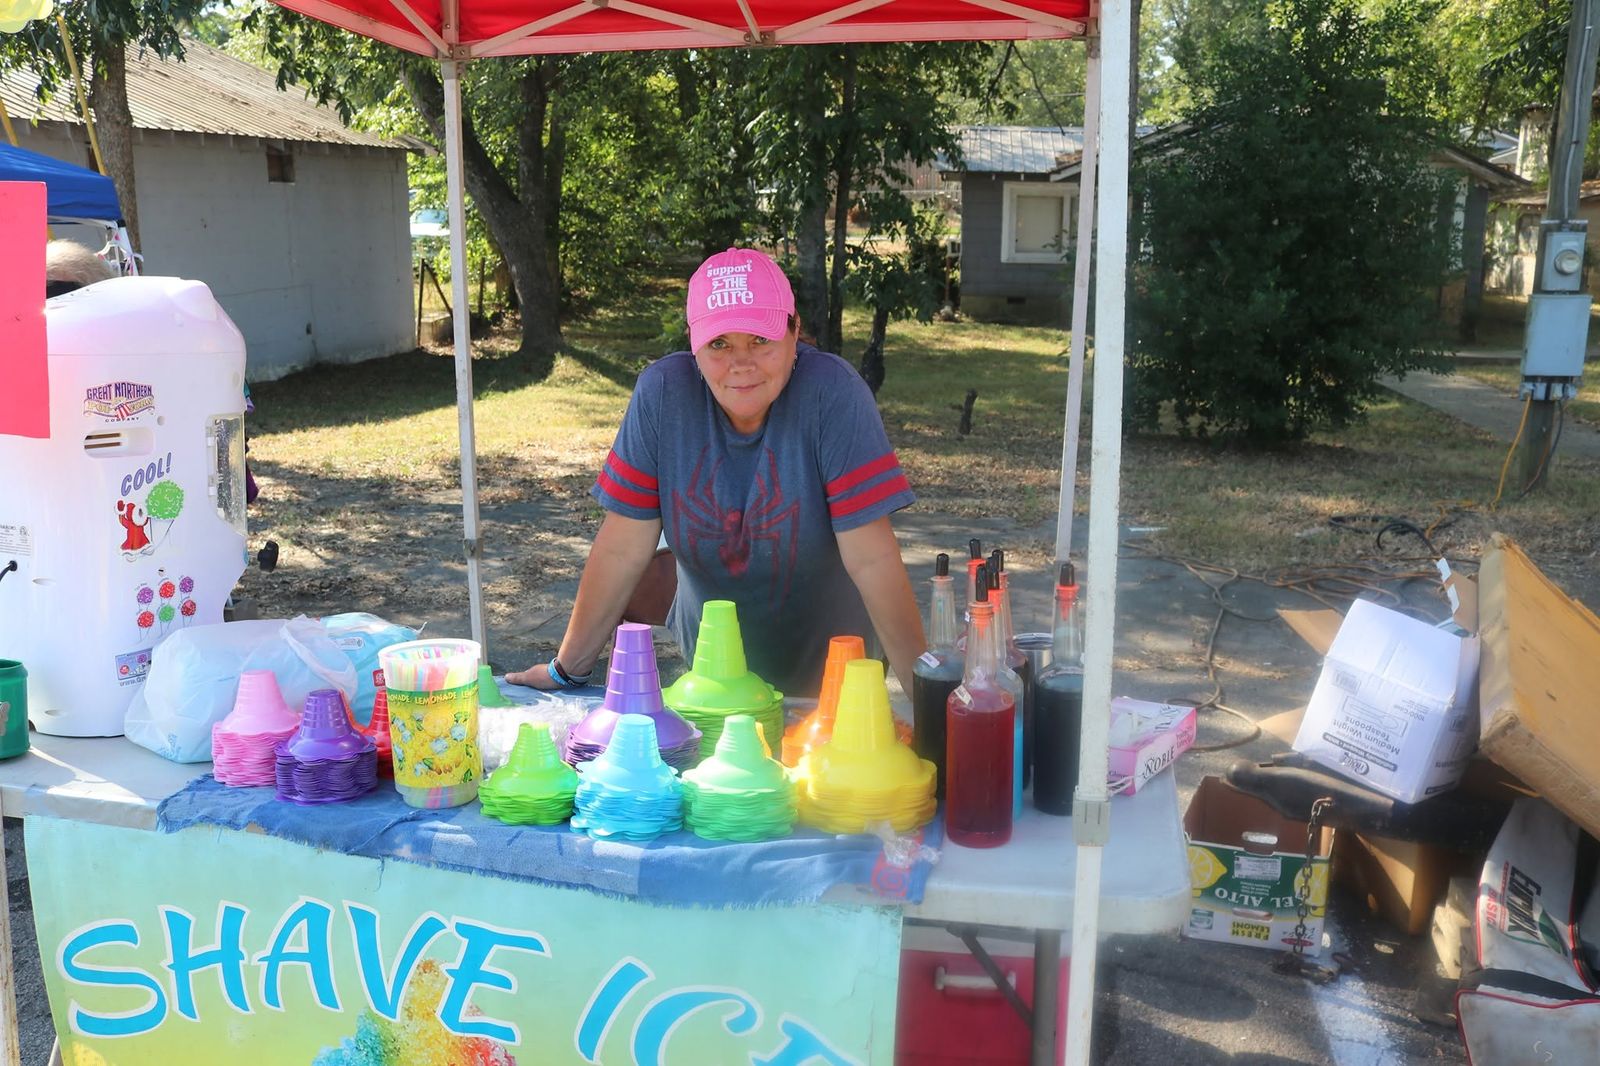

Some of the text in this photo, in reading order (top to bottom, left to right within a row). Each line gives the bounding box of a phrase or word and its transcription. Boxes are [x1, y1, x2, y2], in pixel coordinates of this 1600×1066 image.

[706, 262, 752, 278] support
[723, 276, 748, 289] THE
[706, 290, 754, 310] cure
[86, 381, 152, 401] GREAT NORTHERN
[120, 451, 172, 497] COOL!
[415, 691, 457, 705] LEMONADE
[1332, 719, 1362, 738] Weight
[1345, 716, 1390, 741] Teaspoons
[1364, 733, 1400, 755] Medium
[1213, 887, 1263, 908] ALTO
[1270, 896, 1295, 909] EL
[1232, 921, 1270, 934] LEMONS
[1232, 928, 1270, 940] FRESH
[58, 897, 552, 1043] SHAVE
